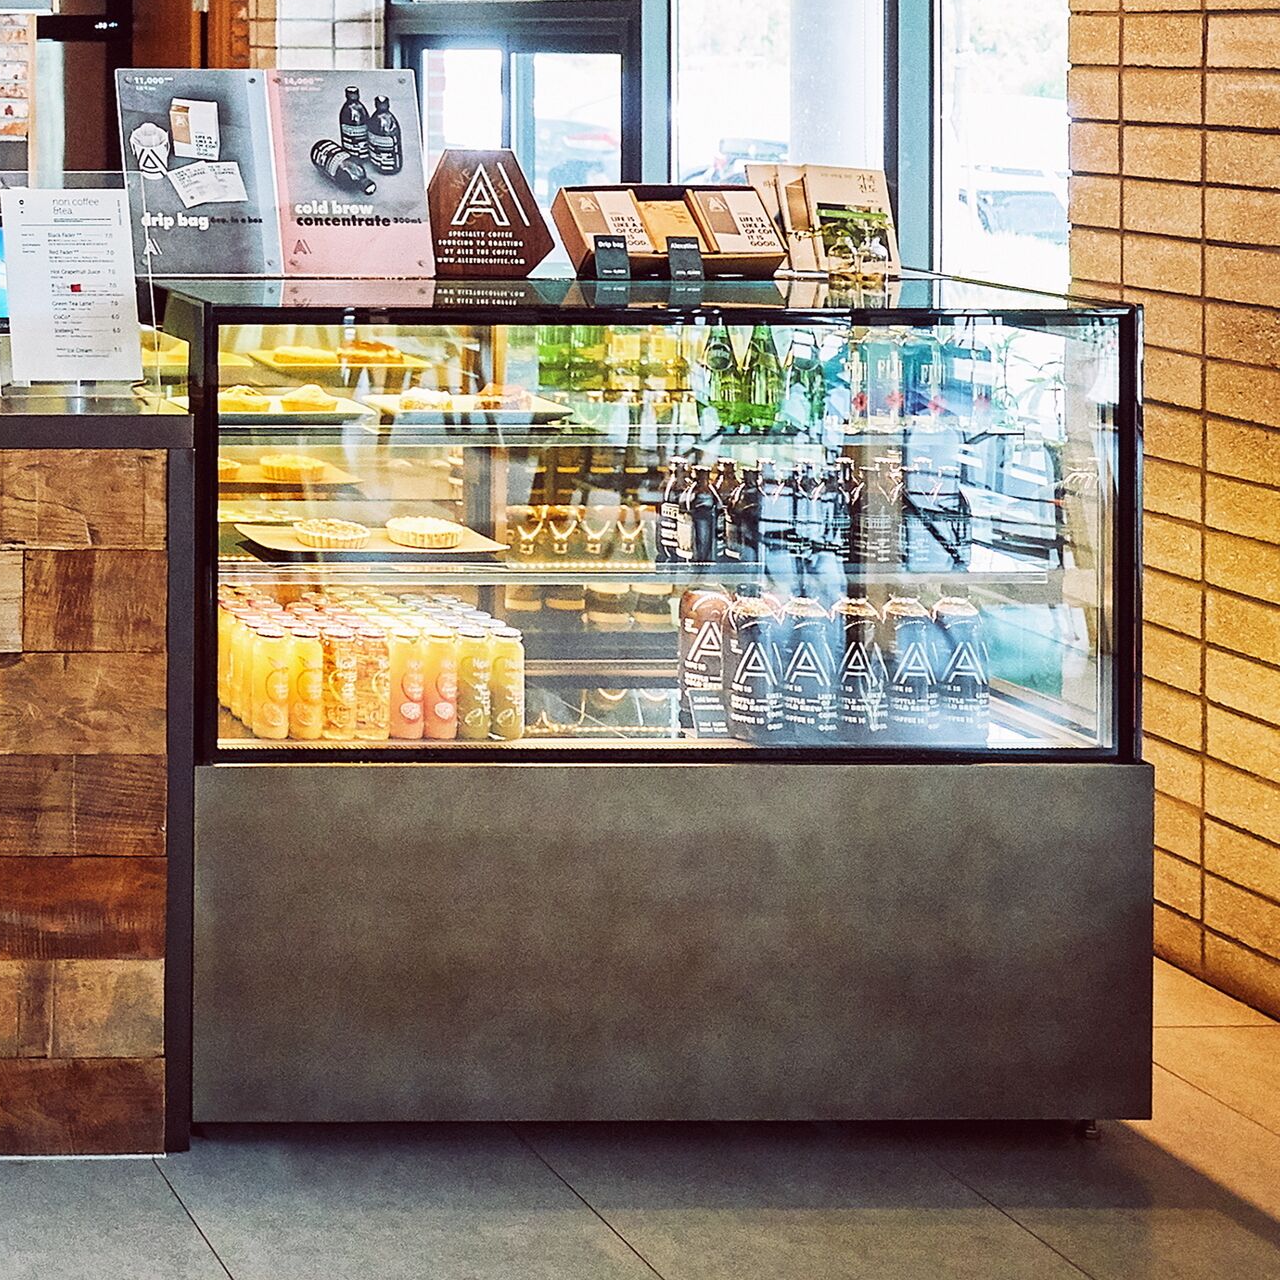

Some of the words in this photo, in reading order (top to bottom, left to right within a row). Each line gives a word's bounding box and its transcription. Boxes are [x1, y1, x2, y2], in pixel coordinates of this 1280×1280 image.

[294, 200, 328, 215] cold
[332, 200, 374, 215] brew
[141, 211, 175, 230] drip
[177, 211, 209, 230] bag
[296, 215, 391, 227] concentrate
